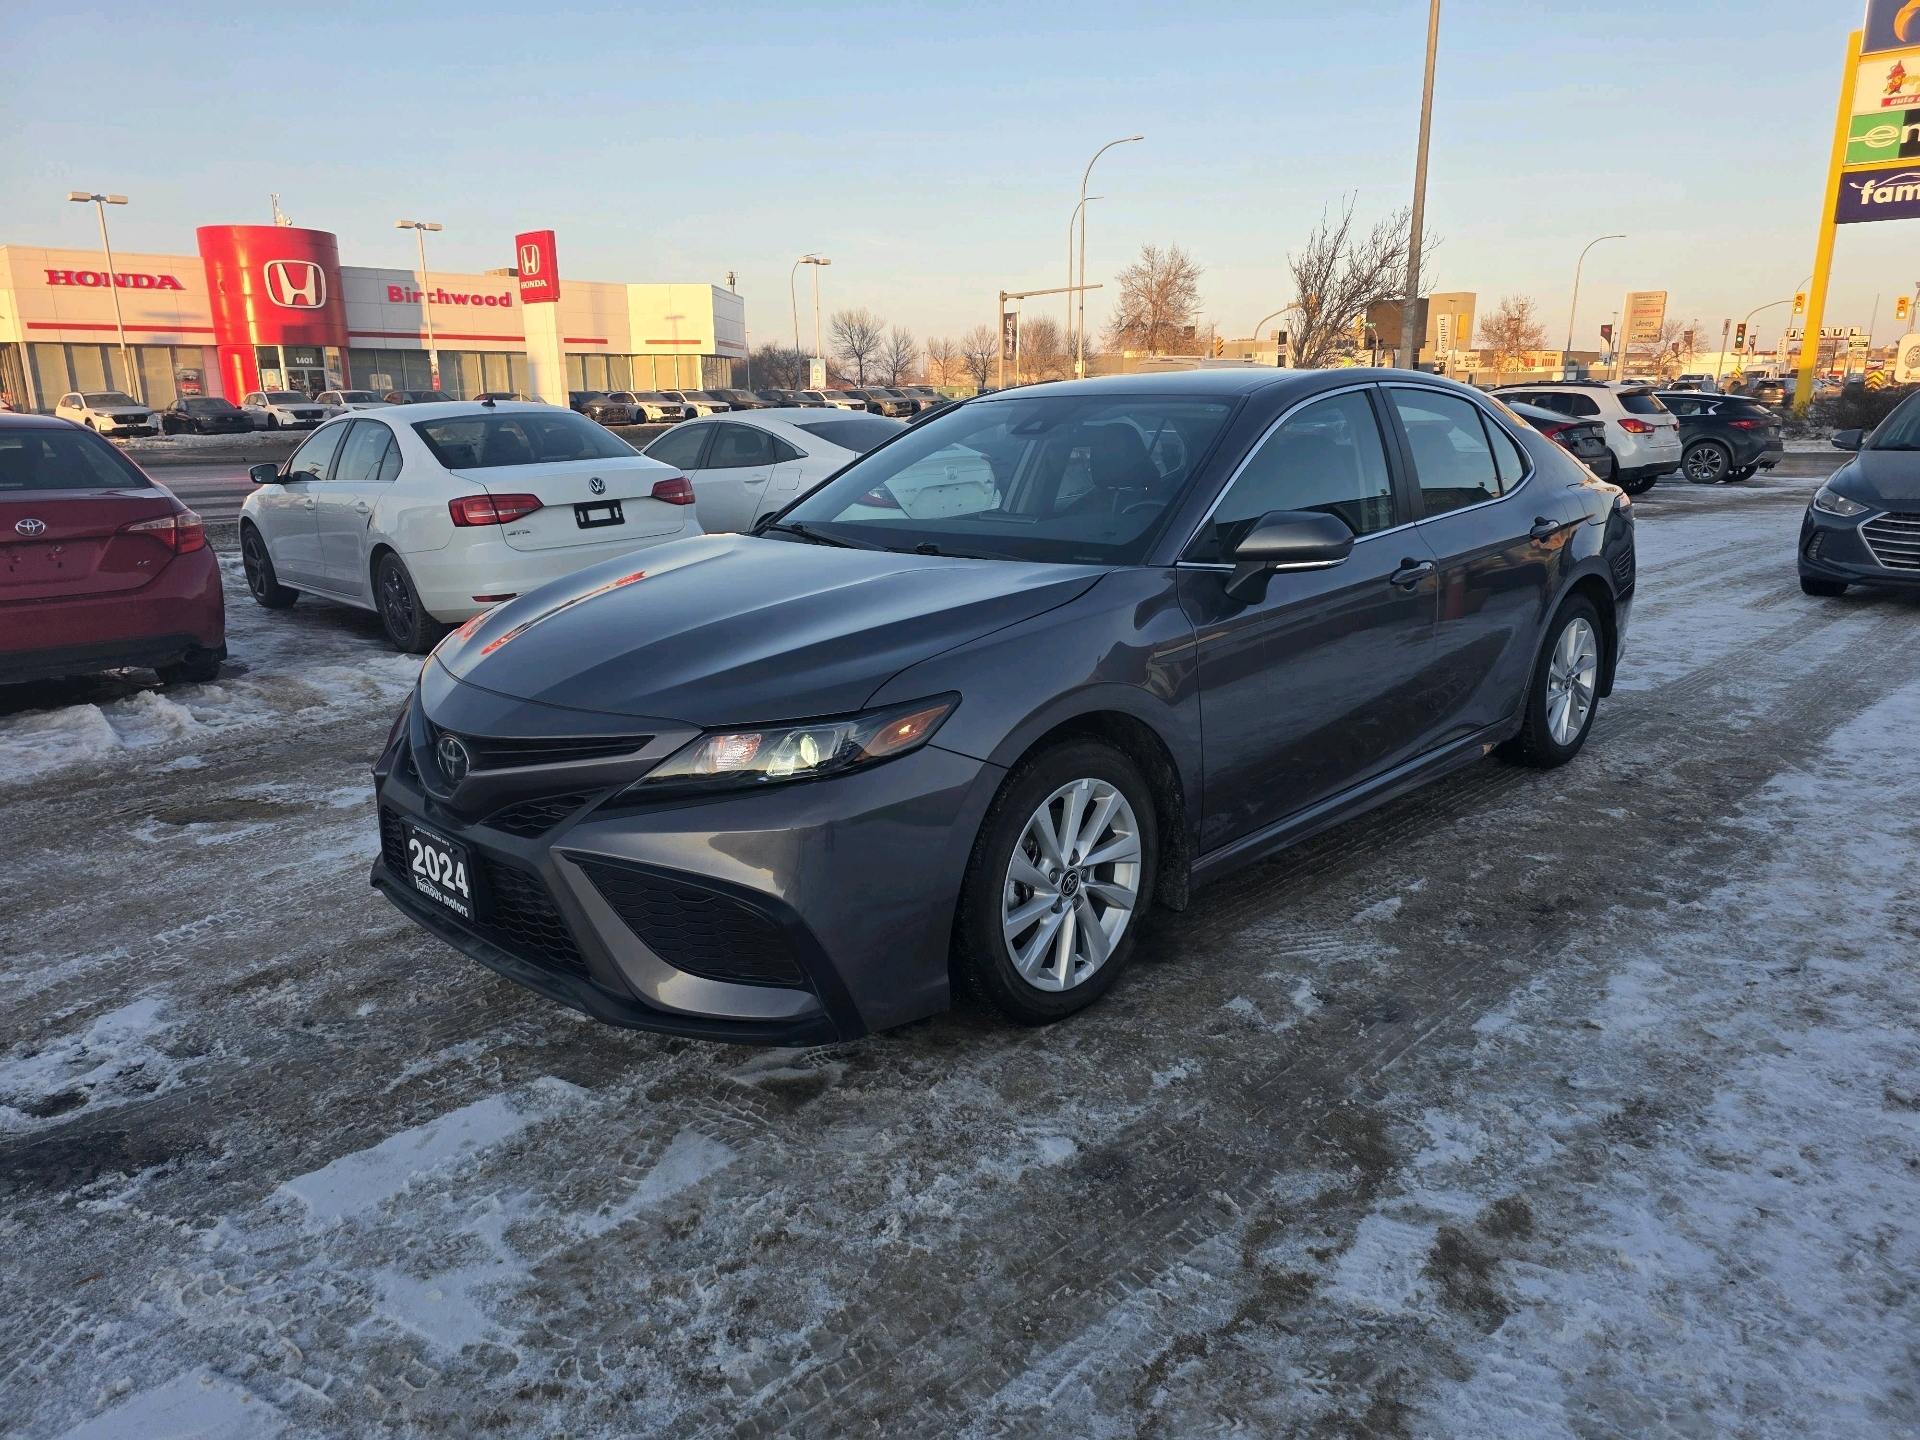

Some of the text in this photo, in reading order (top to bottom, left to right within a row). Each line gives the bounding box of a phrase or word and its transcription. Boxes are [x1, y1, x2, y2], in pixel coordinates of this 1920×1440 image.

[1890, 96, 1915, 106] auto
[44, 269, 187, 291] HONDA
[520, 279, 548, 290] HONDA
[387, 285, 513, 307] Birchwood
[1635, 320, 1655, 328] Jeep
[1785, 328, 1857, 338] U-AUL
[295, 356, 313, 365] 1401
[409, 838, 469, 899] 2024
[443, 894, 469, 918] motors
